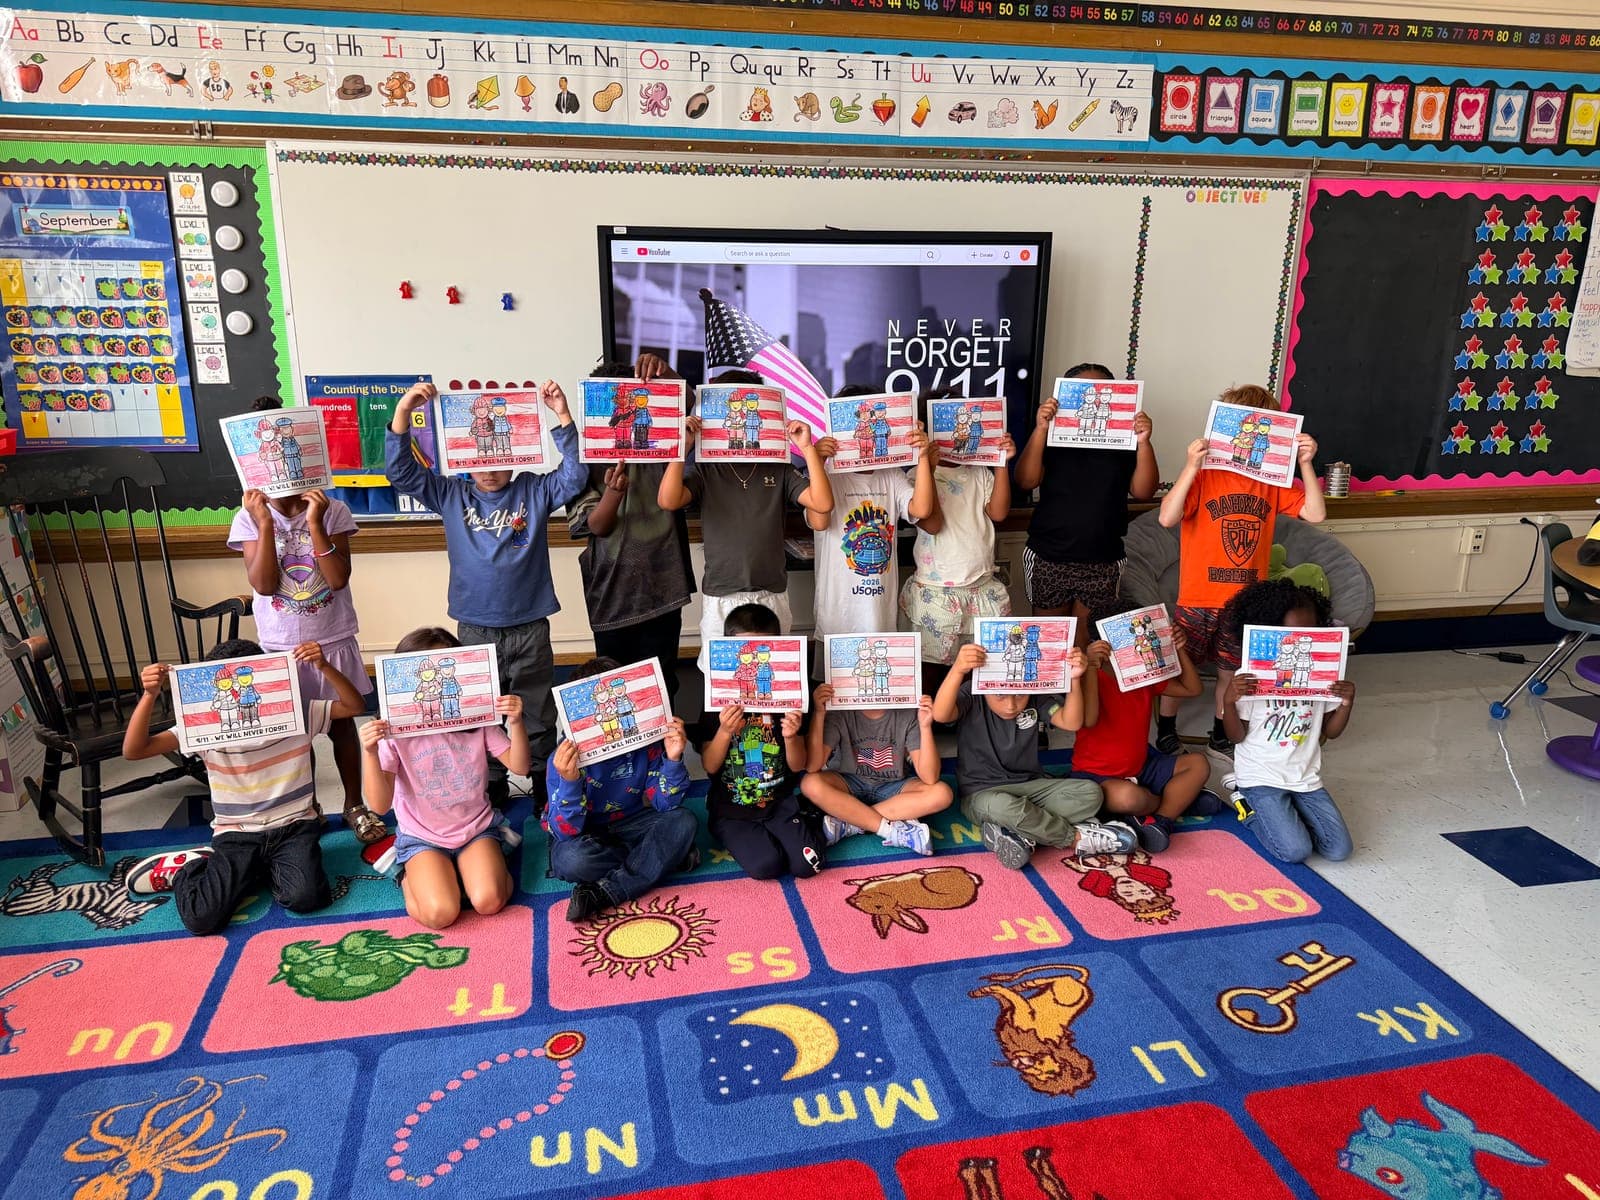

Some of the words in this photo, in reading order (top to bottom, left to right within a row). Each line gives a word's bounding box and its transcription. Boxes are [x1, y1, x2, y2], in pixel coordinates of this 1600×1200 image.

[960, 1, 974, 13] 48
[978, 1, 992, 14] 49
[999, 3, 1013, 15] 50
[1018, 4, 1029, 16] 51
[1035, 5, 1048, 17] 52
[1052, 6, 1066, 17] 53
[1070, 6, 1083, 18] 54
[1087, 7, 1100, 19] 55
[1104, 8, 1117, 20] 56
[1121, 9, 1134, 21] 57
[1141, 11, 1155, 23] 58
[1158, 12, 1171, 24] 59
[1175, 12, 1189, 25] 60
[1193, 13, 1204, 26] 61
[1208, 14, 1221, 26] 62
[1225, 15, 1238, 27] 63
[1241, 15, 1254, 28] 64
[1257, 16, 1270, 29] 65
[1277, 18, 1290, 31] 66
[1293, 19, 1306, 32] 67
[1308, 20, 1322, 32] 68
[1324, 20, 1337, 33] 69
[1341, 22, 1352, 34] 70
[1358, 22, 1367, 35] 71
[1372, 24, 1384, 36] 72
[1387, 24, 1400, 36] 73
[1406, 25, 1418, 37] 74
[1421, 26, 1433, 38] 75
[1437, 27, 1448, 39] 76
[1453, 27, 1464, 40] 77
[1467, 28, 1479, 40] 78
[1482, 29, 1494, 41] 79
[1496, 30, 1509, 42] 80
[1512, 31, 1522, 43] 81
[1529, 32, 1541, 44] 82
[1544, 33, 1555, 45] 83
[1559, 34, 1570, 45] 84
[1574, 34, 1586, 46] 85
[10, 17, 39, 40] Aa
[56, 19, 84, 43] Bb
[104, 22, 131, 45] Cc
[150, 24, 178, 47] Dd
[197, 26, 223, 50] Ee
[244, 29, 267, 51] Ff
[283, 31, 316, 64] Gg
[336, 34, 363, 56] Hh
[381, 36, 403, 58] Ii
[426, 38, 445, 70] Jj
[473, 40, 497, 62] Kk
[515, 42, 531, 64] Ll
[548, 43, 582, 66] Mm
[594, 46, 619, 68] Nn
[639, 48, 670, 71] Oo
[689, 51, 710, 82] Pp
[730, 53, 757, 76] Qu
[763, 64, 782, 85] qu
[798, 56, 816, 78] Rr
[837, 58, 854, 79] Ss
[871, 60, 891, 81] Tt
[911, 63, 931, 83] Uu
[952, 64, 975, 85] Vv
[990, 65, 1021, 86] Ww
[1034, 66, 1056, 87] Xx
[1076, 67, 1097, 97] Yy
[1116, 69, 1134, 89] Zz
[211, 84, 222, 92] ED
[1169, 113, 1188, 121] circle
[1210, 114, 1233, 123] triangle
[1251, 116, 1273, 124] square
[1293, 118, 1318, 126] rectangle
[1334, 119, 1358, 127] hexagon
[1459, 123, 1475, 131] heart
[1495, 124, 1516, 132] diamond
[173, 174, 195, 183] LEVEL
[1186, 190, 1268, 204] OBJECTIVES
[40, 212, 113, 232] September
[179, 220, 201, 228] LEVEL
[649, 248, 671, 257] YouTube
[185, 263, 206, 272] LEVEL
[191, 305, 212, 314] LEVEL
[888, 319, 1012, 337] NEVER
[196, 346, 218, 355] LEVEL
[887, 336, 1011, 368] FORGET
[323, 385, 369, 396] Counting
[371, 385, 388, 394] the
[370, 402, 388, 411] tens
[414, 414, 424, 426] 6
[1205, 494, 1272, 523] RAHWAY
[489, 502, 529, 538] York
[1228, 521, 1257, 529] POLICE
[443, 719, 463, 727] NEVER
[464, 715, 487, 724] FORGET
[1264, 711, 1311, 742] Mom
[225, 732, 243, 740] WILL
[243, 729, 264, 738] NEVER
[265, 724, 289, 734] FORGET
[601, 745, 611, 753] WE
[611, 741, 625, 749] WILL
[625, 736, 643, 745] NEVER
[992, 913, 1063, 944] Rr
[728, 947, 797, 978] Ss
[449, 983, 517, 1016] Tt
[1357, 1002, 1459, 1041] Kk
[69, 1021, 175, 1060] Uu
[1131, 1041, 1207, 1084] Ll
[794, 1078, 940, 1129] Mm
[530, 1123, 638, 1173] Nn
